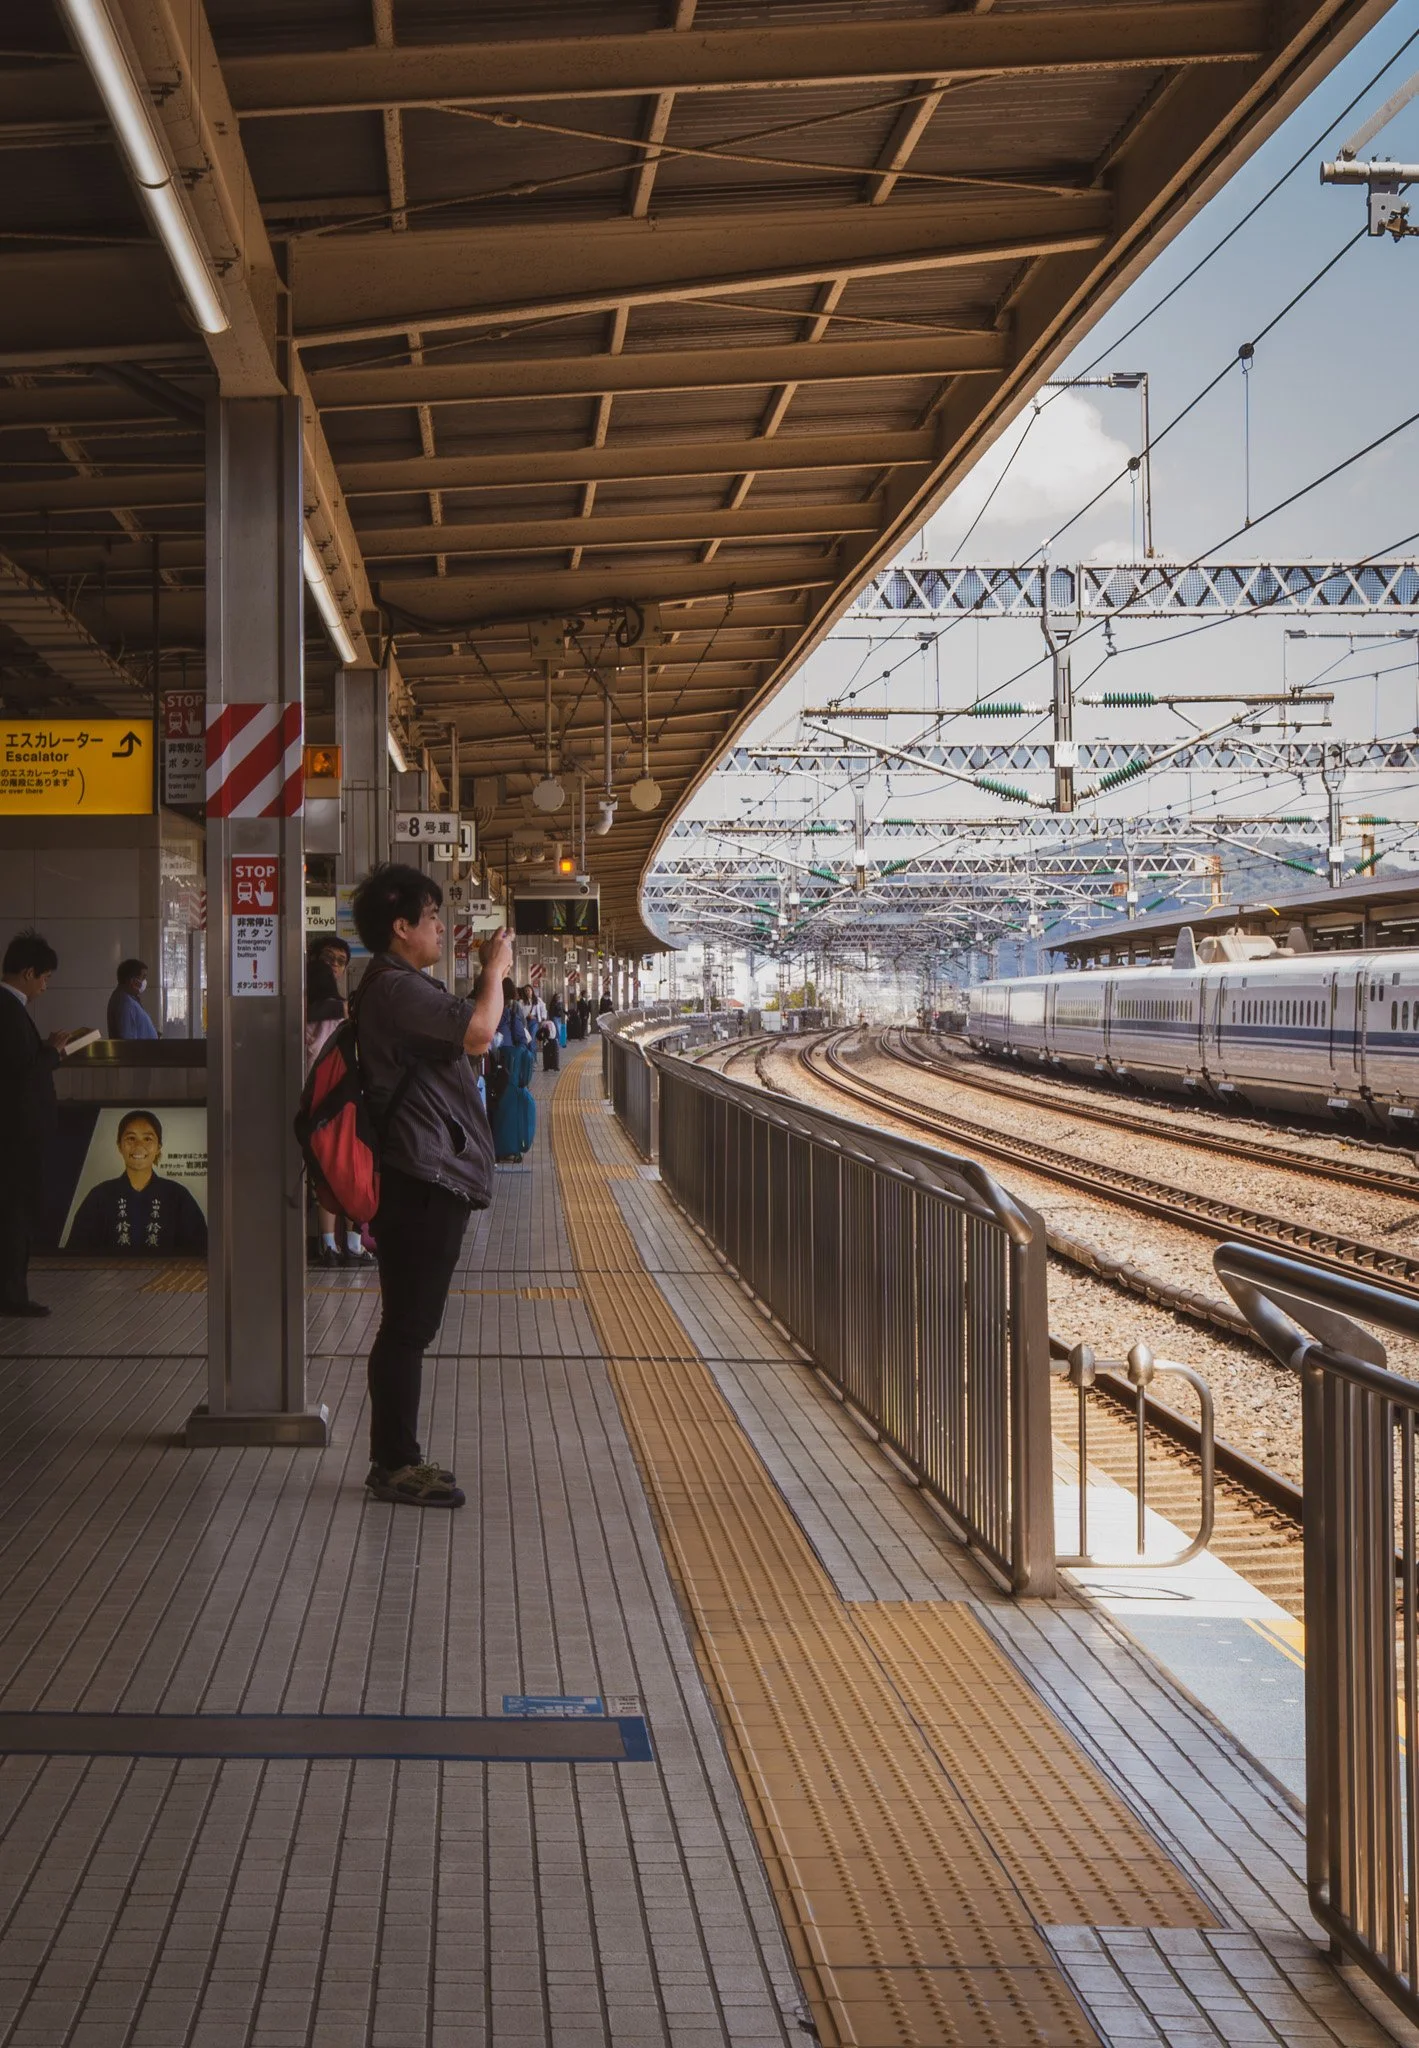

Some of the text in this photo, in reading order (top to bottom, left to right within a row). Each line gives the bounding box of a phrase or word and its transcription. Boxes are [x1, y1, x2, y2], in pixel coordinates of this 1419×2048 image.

[167, 695, 203, 707] STOP
[6, 731, 103, 748] エスカレーター
[168, 742, 203, 753] 非常停止
[6, 751, 69, 761] Escalator
[168, 758, 202, 768] ボタン
[1, 778, 69, 787] の階段にあります
[235, 865, 276, 878] STOP
[237, 917, 274, 927] 非常停止
[237, 929, 273, 938] ボタン
